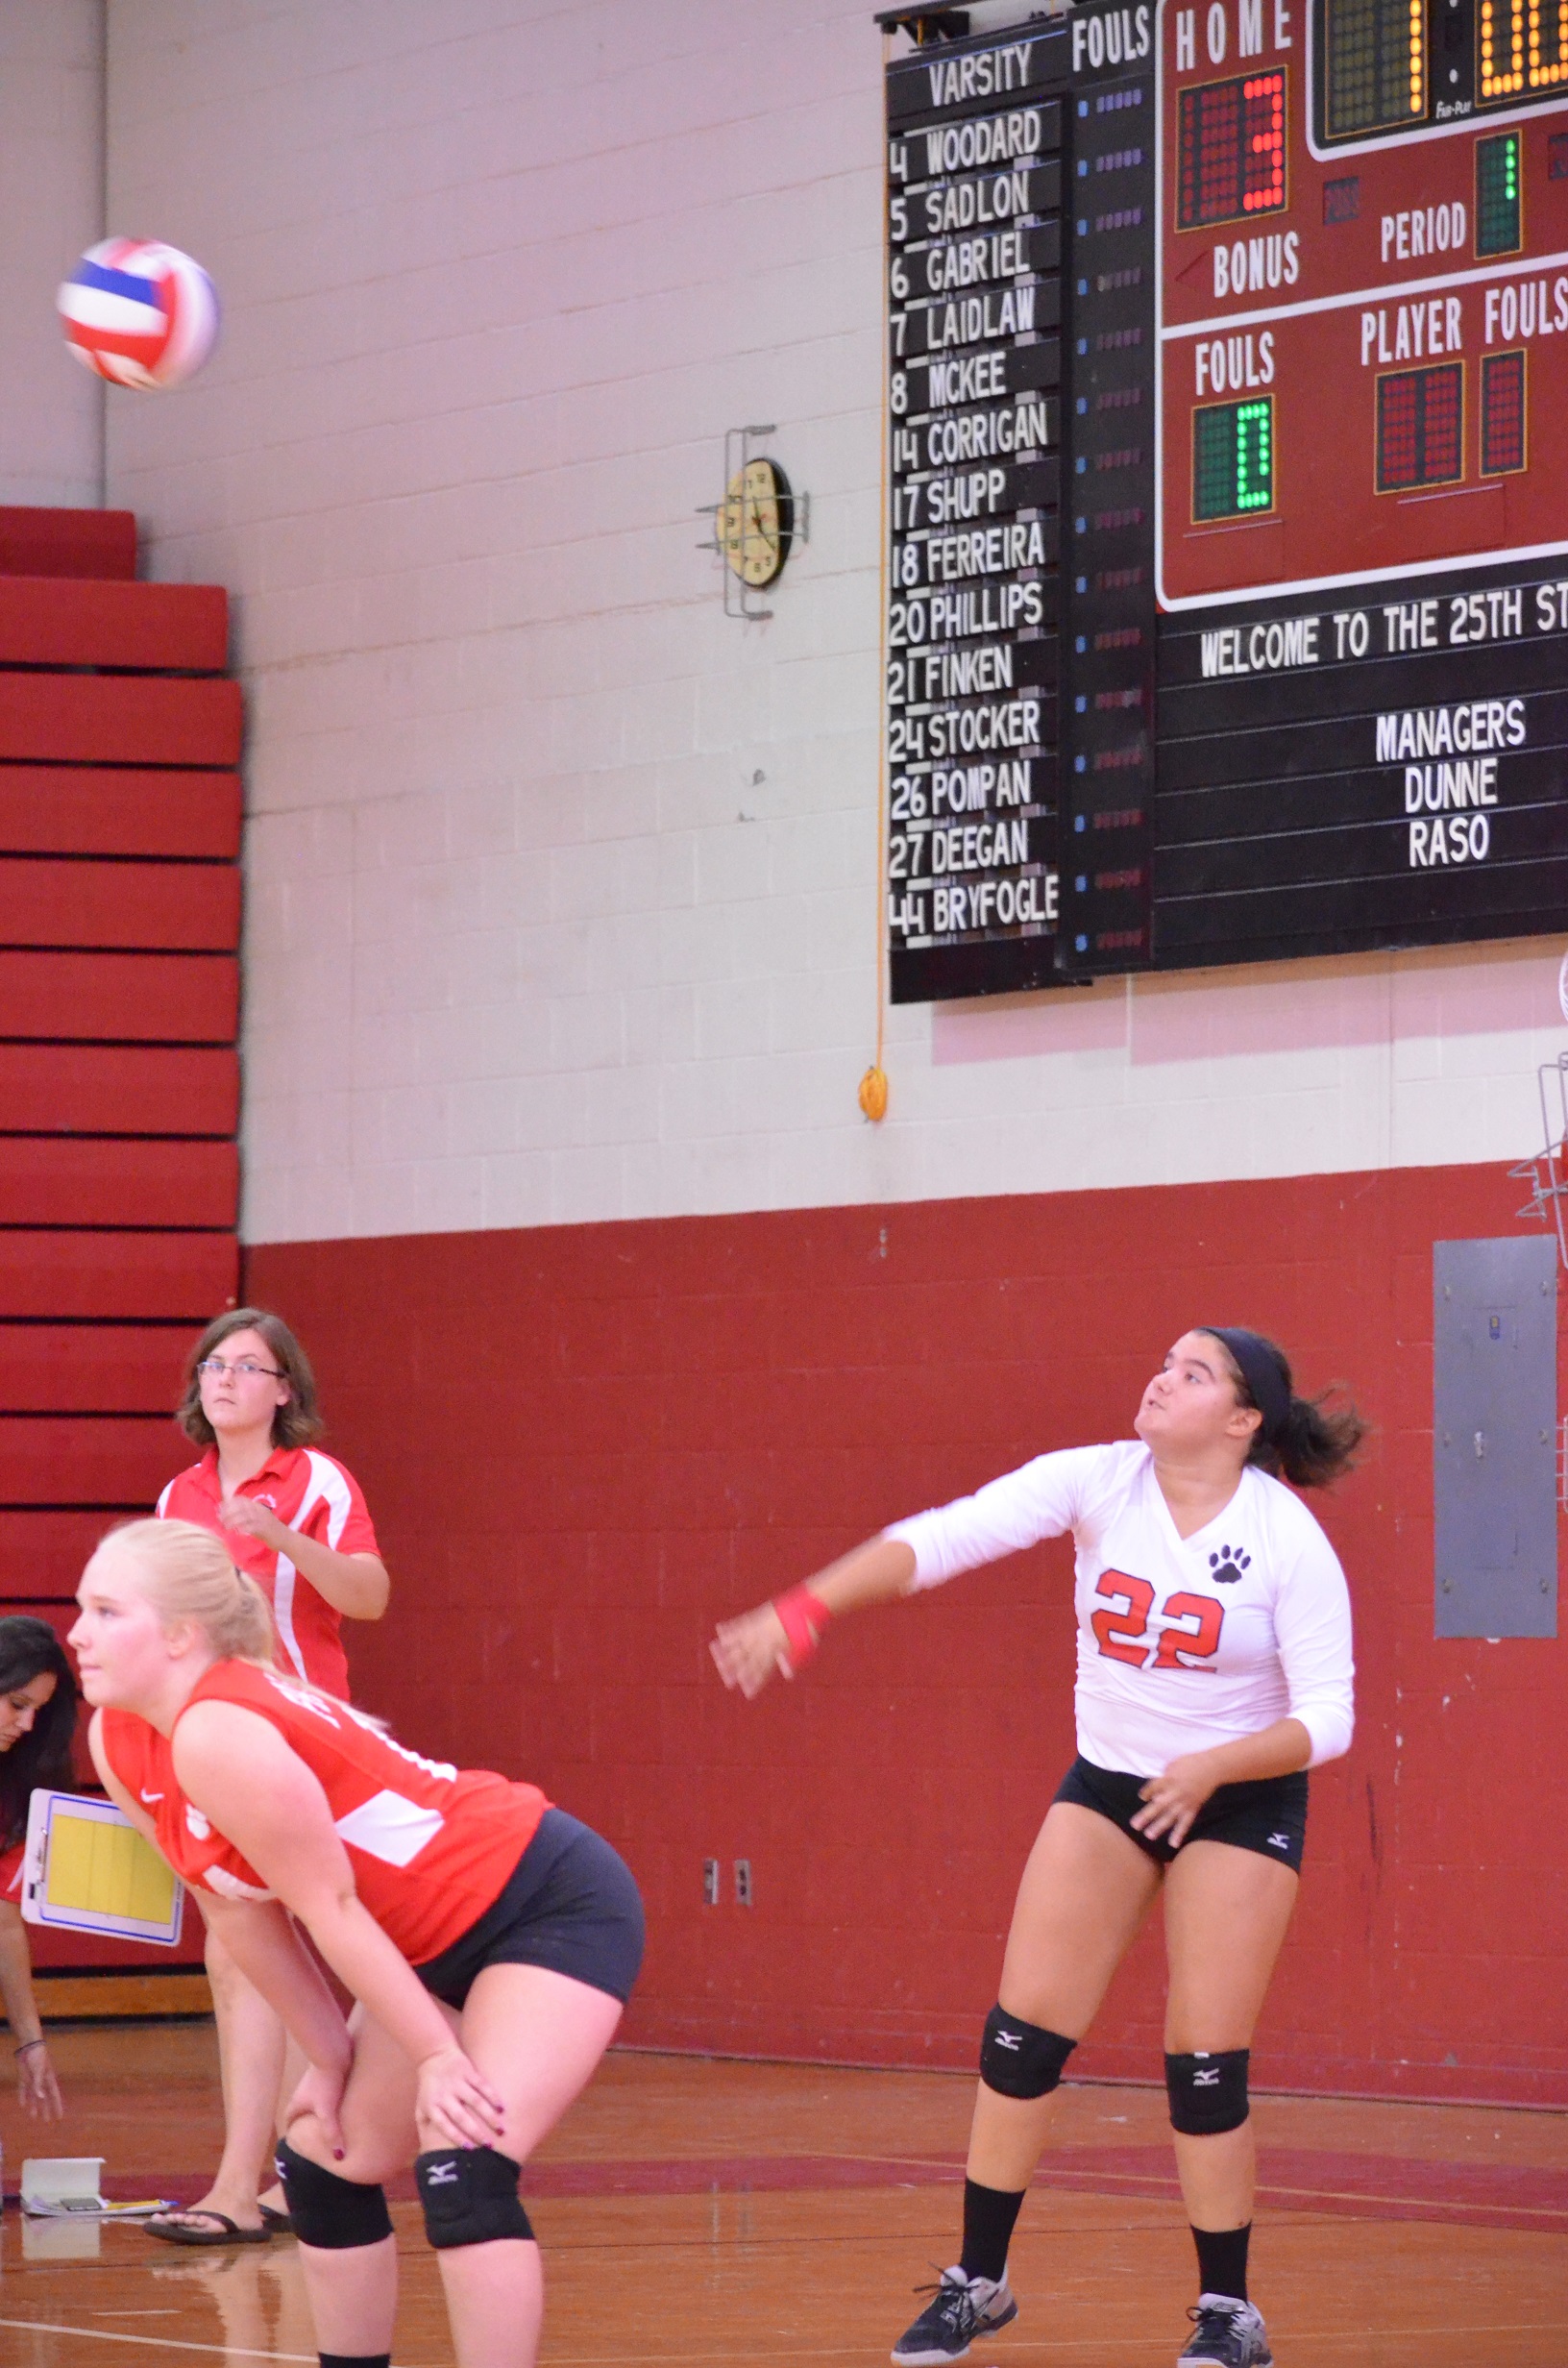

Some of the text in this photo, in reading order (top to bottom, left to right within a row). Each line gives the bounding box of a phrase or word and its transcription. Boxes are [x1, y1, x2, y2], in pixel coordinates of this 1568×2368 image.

[1073, 5, 1149, 71] FOULS
[1176, 0, 1292, 71] HOME
[929, 42, 1031, 107] VARSITY
[890, 110, 1041, 182] 4 WOODARD
[1243, 74, 1284, 211] 3
[891, 172, 1029, 240] 5 SADLON
[1381, 202, 1466, 262] PERIOD
[892, 232, 1030, 299] 6 GABRIEL
[1213, 231, 1299, 298] BONUS
[891, 287, 1035, 357] 7 LAIDLAW
[1360, 276, 1568, 366] PLAYER FOULS
[891, 352, 1006, 415] 8 MCKEE
[1195, 331, 1274, 395] FOULS
[894, 403, 1048, 473] 14 CORRIGAN
[894, 470, 1005, 530] 17 SHUPP
[892, 521, 1044, 587] 18 FERREIRA
[890, 581, 1042, 647] 20 PHILLIPS
[1201, 618, 1319, 678] WELCOME
[1334, 611, 1368, 659] TO
[1384, 601, 1438, 653] THE
[1450, 589, 1523, 644] 25TH
[888, 644, 1013, 705] 21 FINKEN
[889, 700, 1041, 762] 24 STOCKER
[1377, 700, 1526, 763] MANAGERS
[891, 761, 1030, 821] 26 POMPAN
[1405, 758, 1498, 813] DUNNE
[889, 820, 1028, 878] 27 DEEGAN
[1409, 814, 1489, 868] RASO
[888, 875, 1059, 935] 44 BRYFOGLE
[1091, 1568, 1225, 1673] 22
